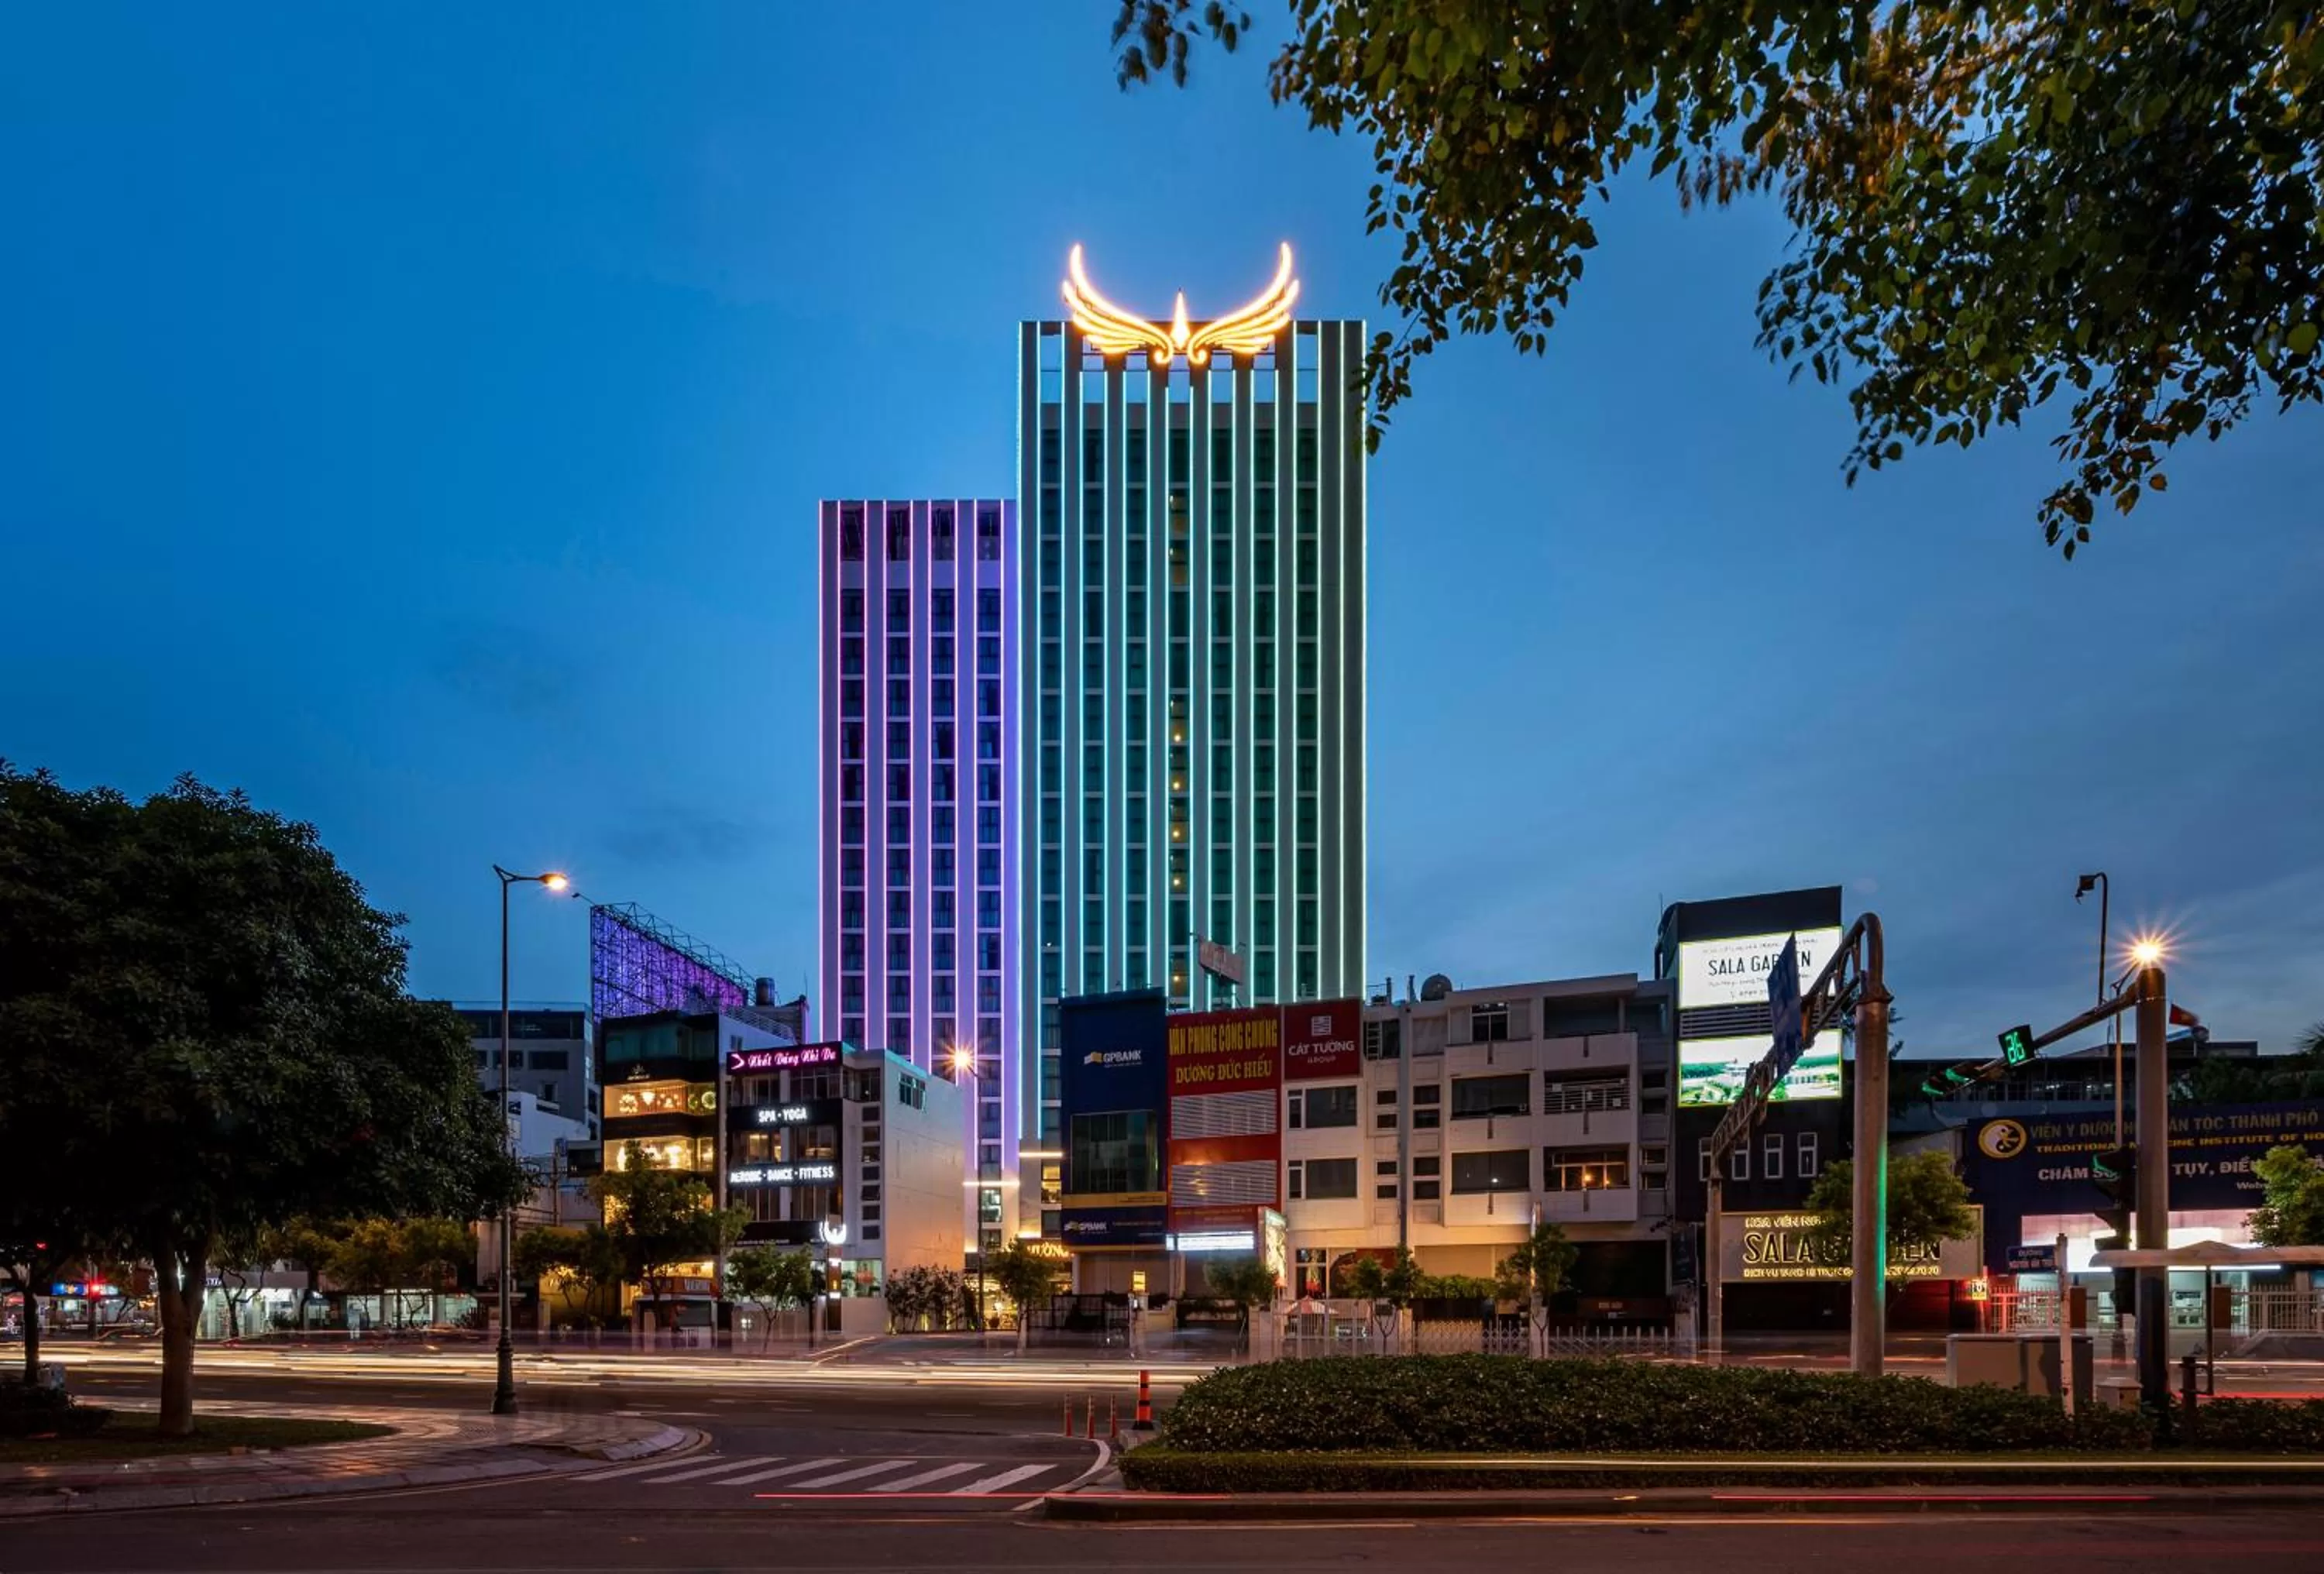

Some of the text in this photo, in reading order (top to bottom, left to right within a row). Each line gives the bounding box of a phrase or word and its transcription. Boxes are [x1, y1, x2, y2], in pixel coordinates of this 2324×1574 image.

[1708, 957, 1745, 977] SALA
[758, 1107, 807, 1122] SPA YOGA
[2036, 1143, 2119, 1153] TRADITIONA
[799, 1166, 834, 1180] FITNESS
[1743, 1231, 1815, 1263] SALA
